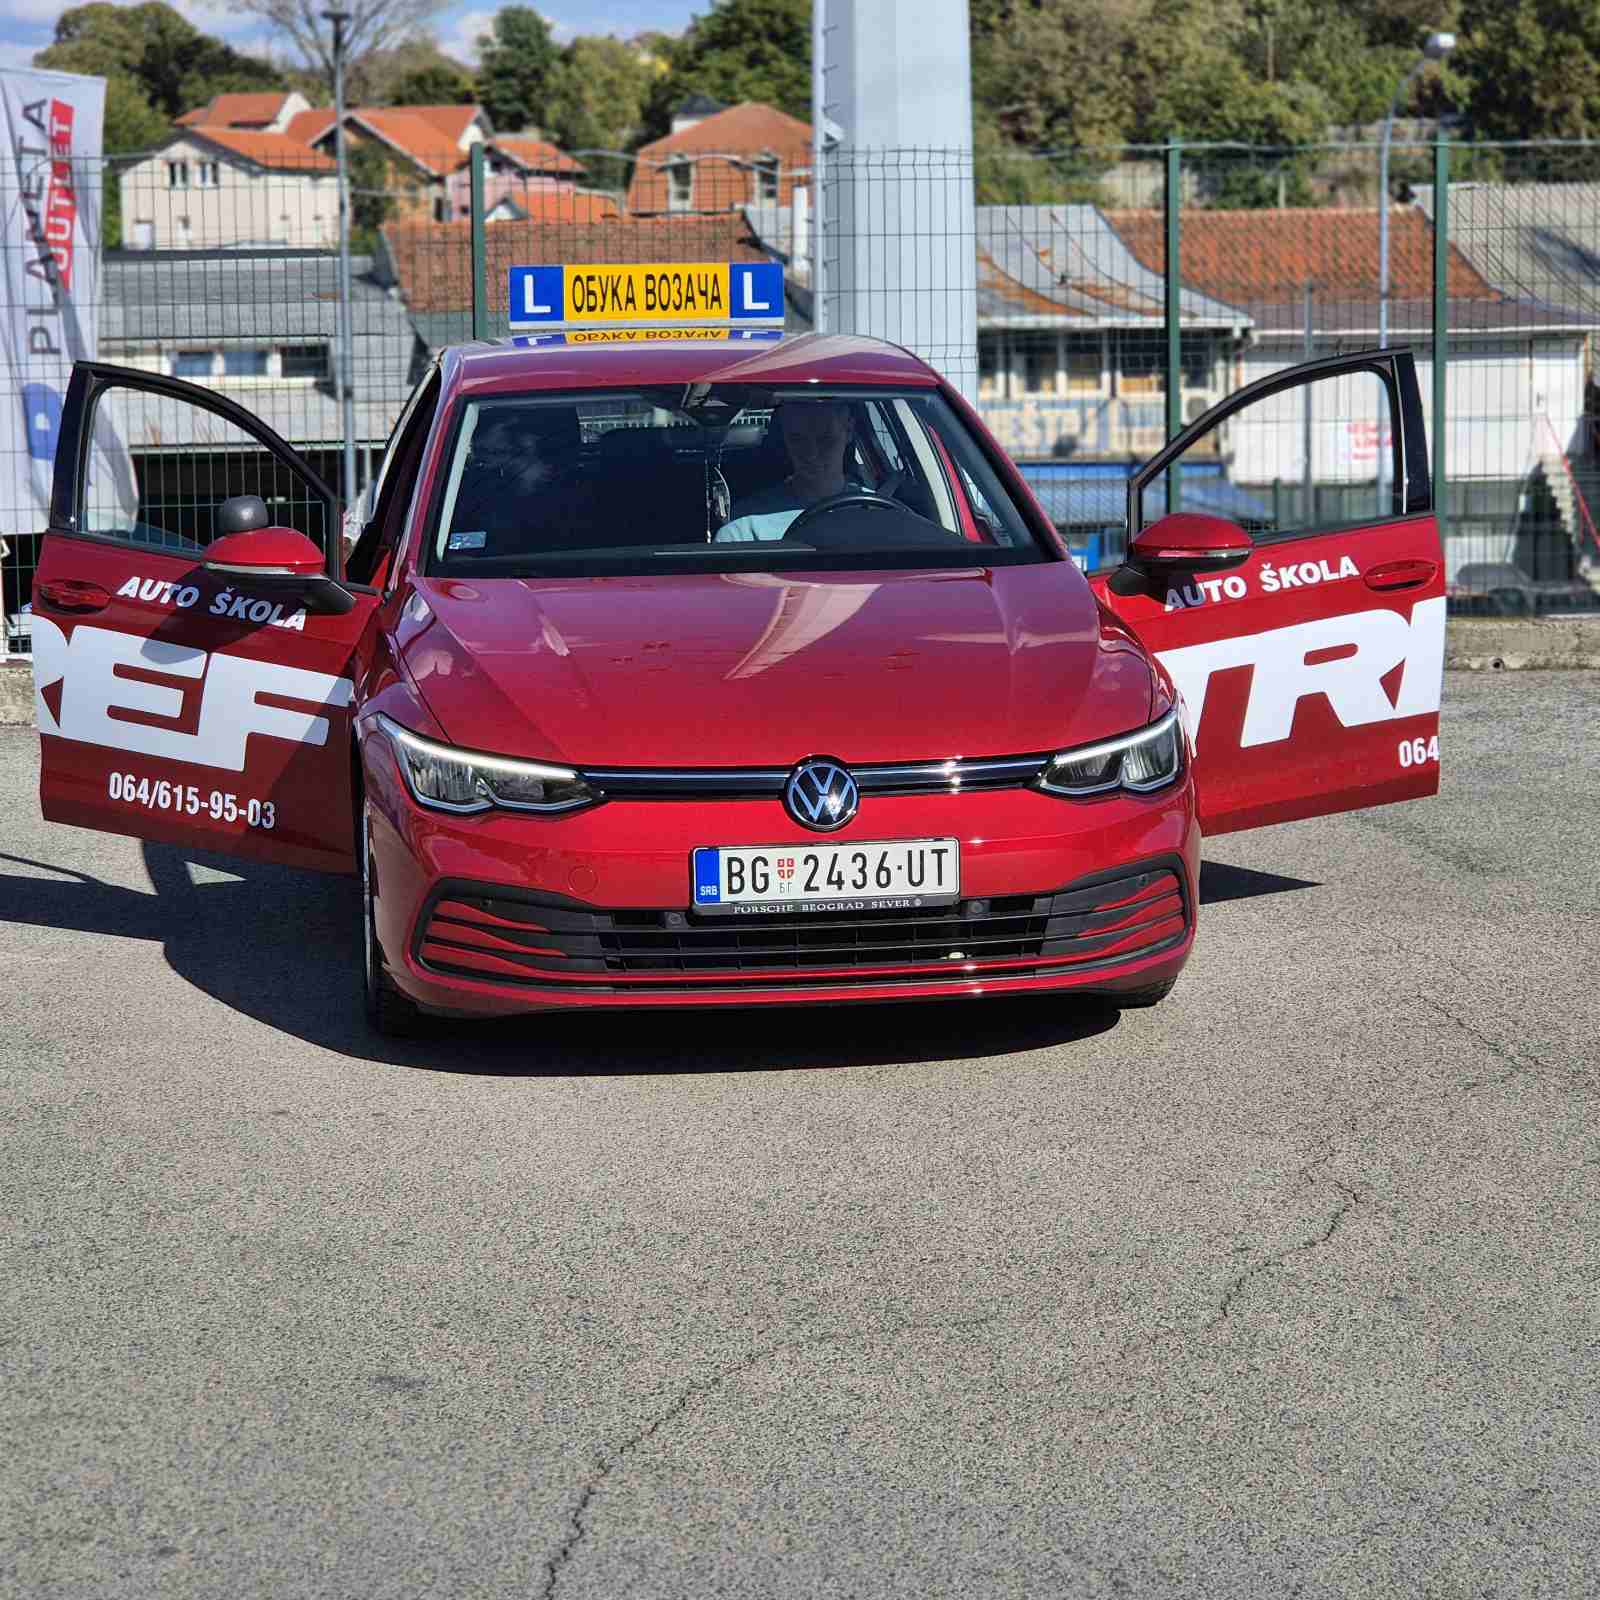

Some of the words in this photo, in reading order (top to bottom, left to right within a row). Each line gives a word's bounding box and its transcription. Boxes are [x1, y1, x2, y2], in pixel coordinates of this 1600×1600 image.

[18, 97, 61, 356] PLANETA
[524, 275, 551, 314] L
[572, 274, 637, 313] ОБУКА
[644, 273, 722, 311] ВОЗАЧА
[743, 272, 770, 310] L
[117, 576, 199, 607] AUTO
[209, 586, 307, 631] ŠKOLA
[1165, 576, 1246, 612] AUTO
[1259, 556, 1360, 592] ŠKOLA
[108, 772, 275, 829] 064/615-95-03
[700, 885, 718, 896] SRB
[727, 856, 770, 895] BG
[734, 904, 794, 913] PORSCHE
[801, 901, 864, 911] BEOGRAD
[871, 899, 910, 909] SEVER
